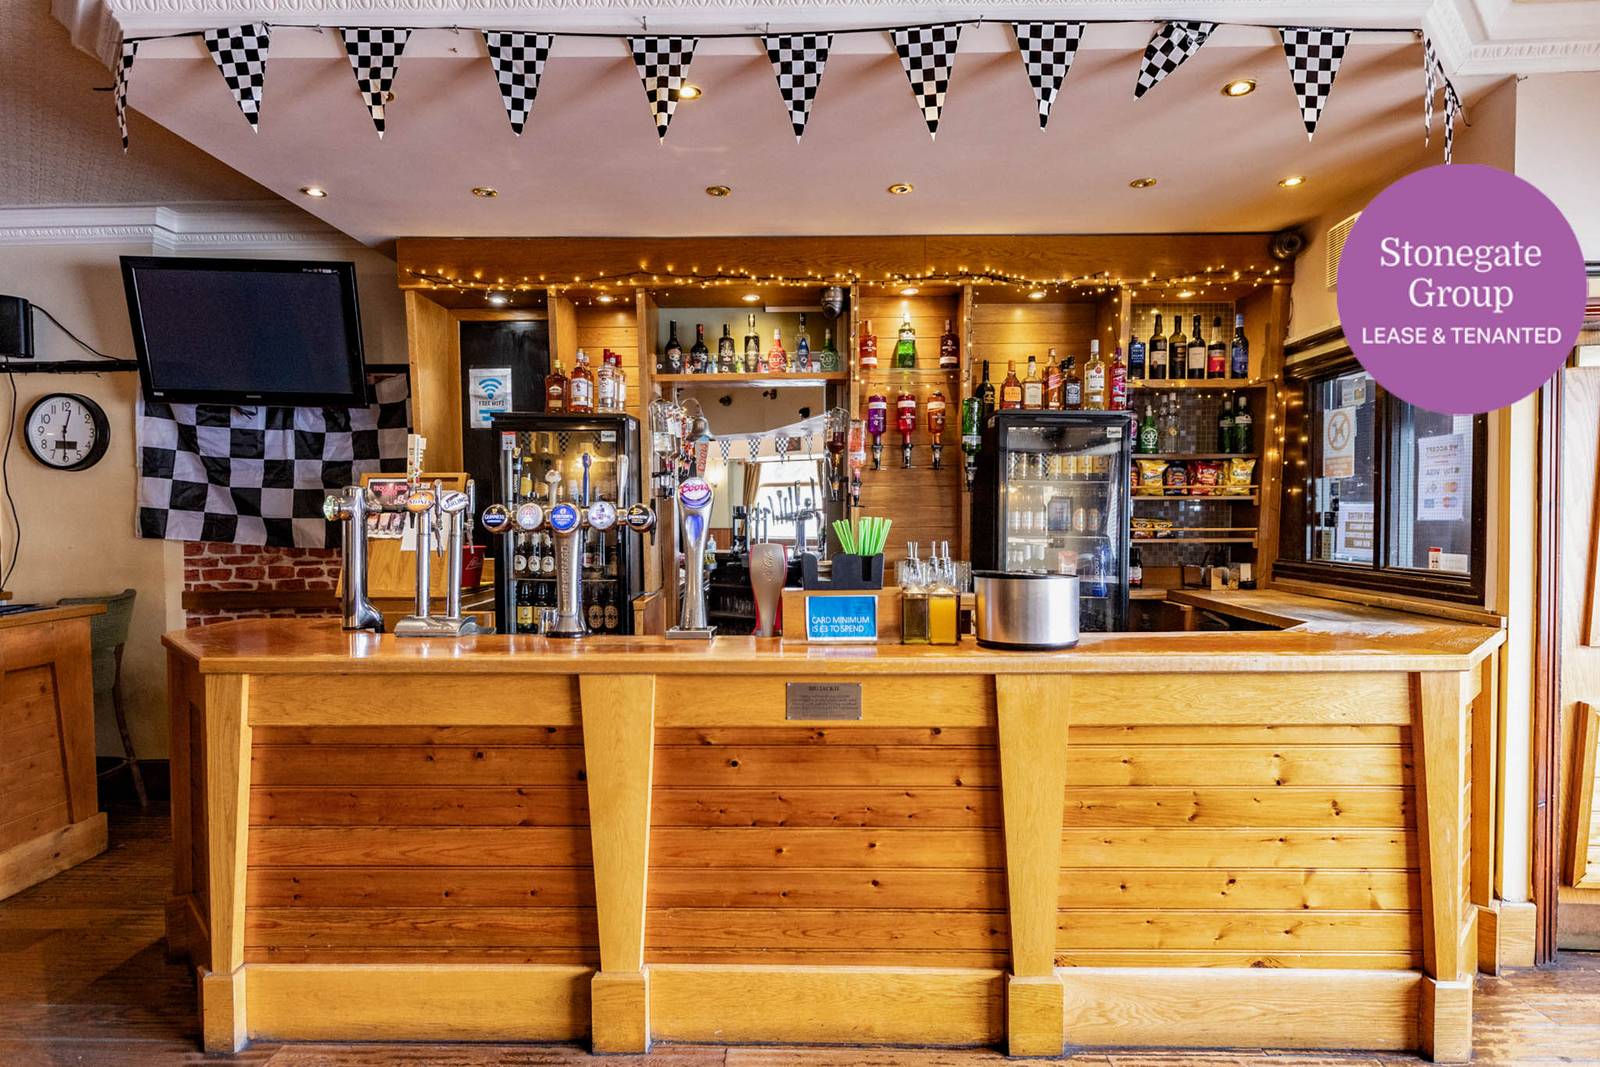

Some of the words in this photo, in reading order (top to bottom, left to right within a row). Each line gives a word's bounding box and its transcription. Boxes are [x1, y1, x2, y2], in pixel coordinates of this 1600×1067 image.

[61, 401, 71, 411] 12
[41, 413, 51, 425] 10
[84, 413, 91, 424] 2
[38, 426, 44, 436] 9
[89, 427, 95, 438] 3
[41, 439, 47, 449] 8
[85, 441, 91, 450] 4
[50, 449, 56, 459] 7
[76, 450, 82, 460] 5
[680, 483, 710, 494] Coors
[443, 496, 467, 510] CARLING
[811, 616, 831, 624] CARD
[833, 616, 870, 624] MINIMUM
[811, 625, 819, 633] IS
[841, 625, 865, 633] SPEND
